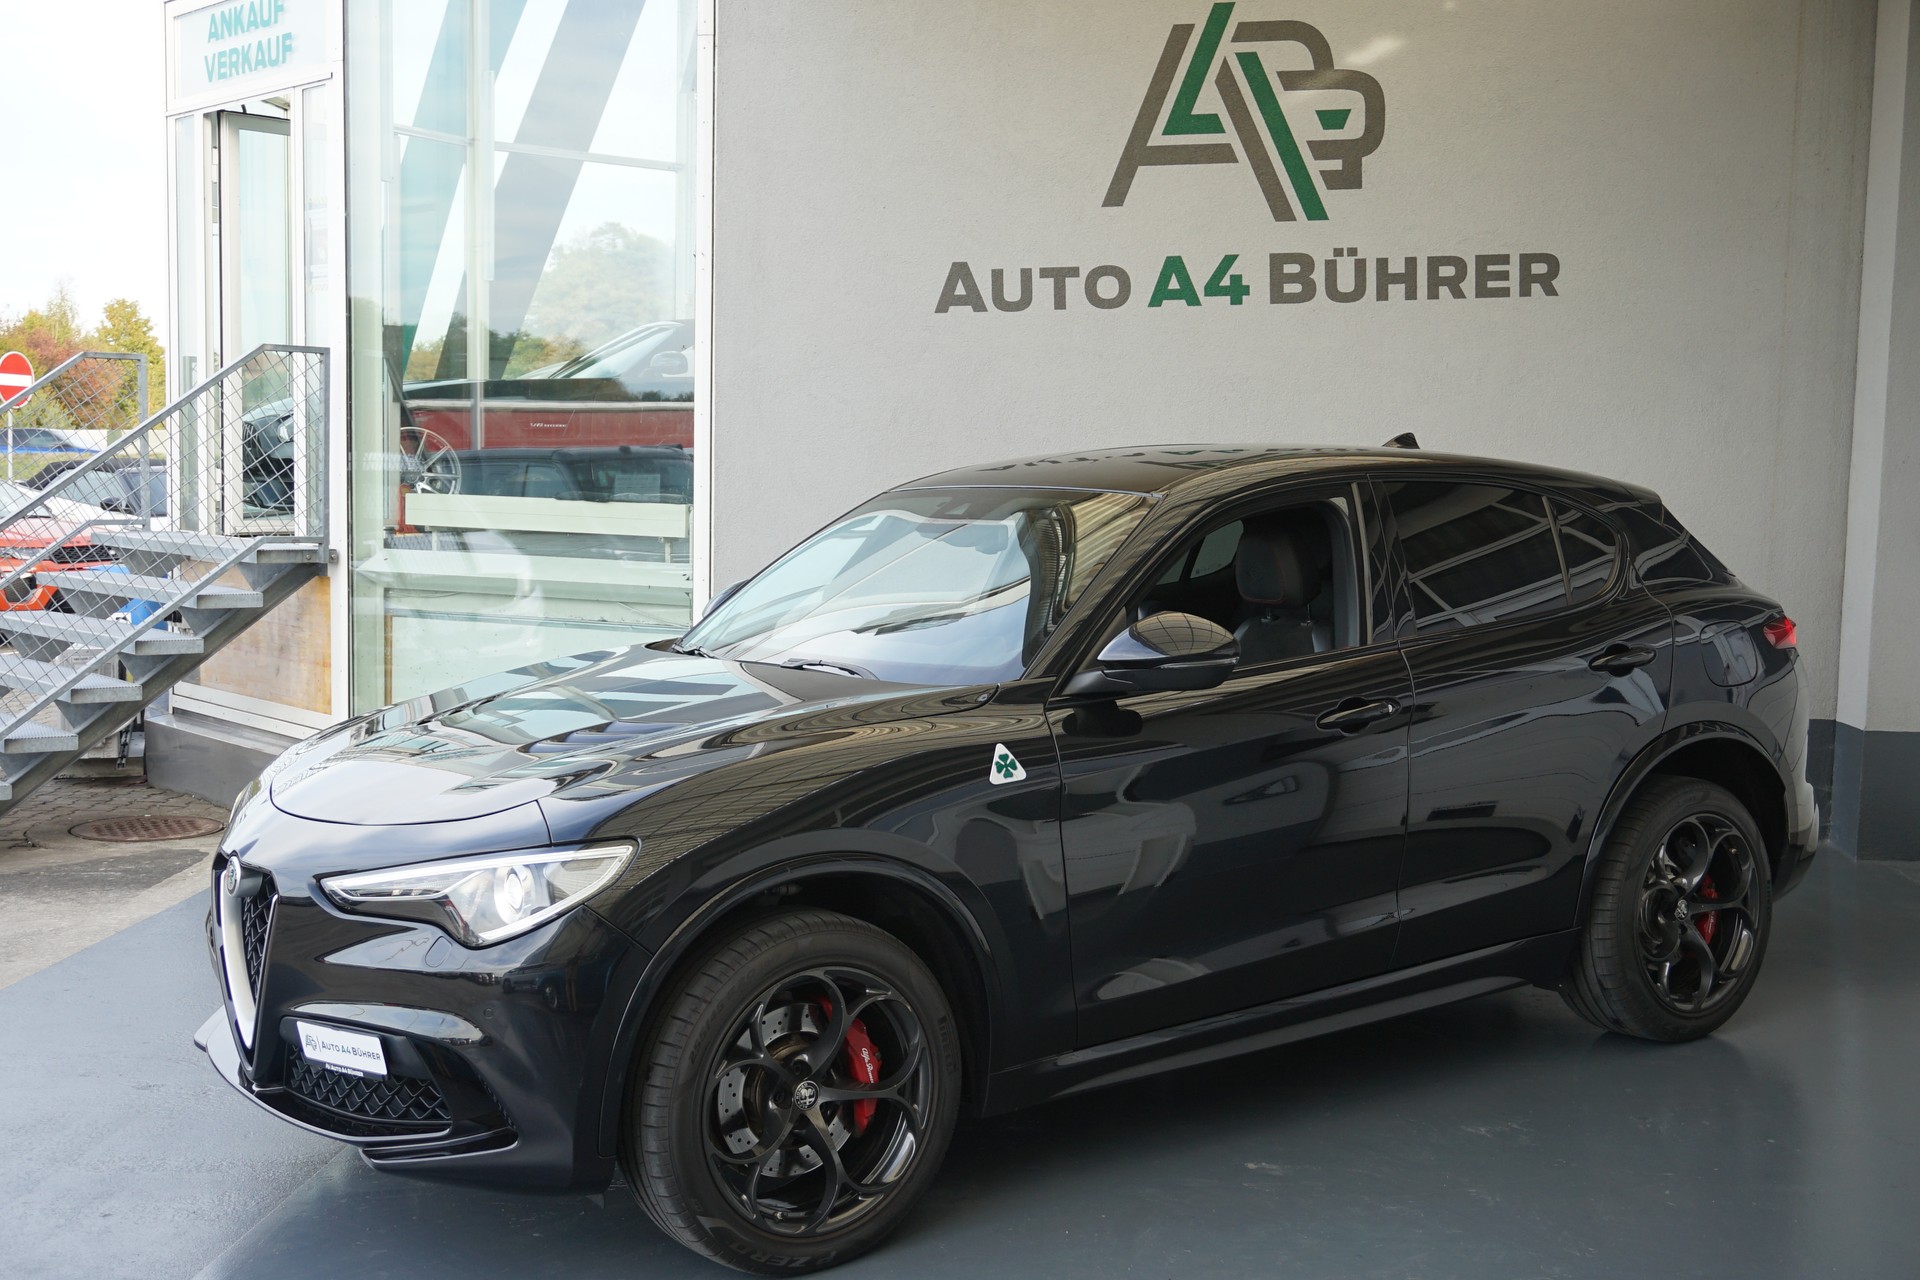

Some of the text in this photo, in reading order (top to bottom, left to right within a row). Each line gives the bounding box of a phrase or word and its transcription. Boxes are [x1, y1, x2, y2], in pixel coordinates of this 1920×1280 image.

[208, 0, 284, 43] ANKAUF
[204, 32, 293, 83] VERKAUF
[934, 247, 1561, 314] AUTO A4 BÜHRER
[321, 1040, 382, 1061] AUTO A4 BÜHRER
